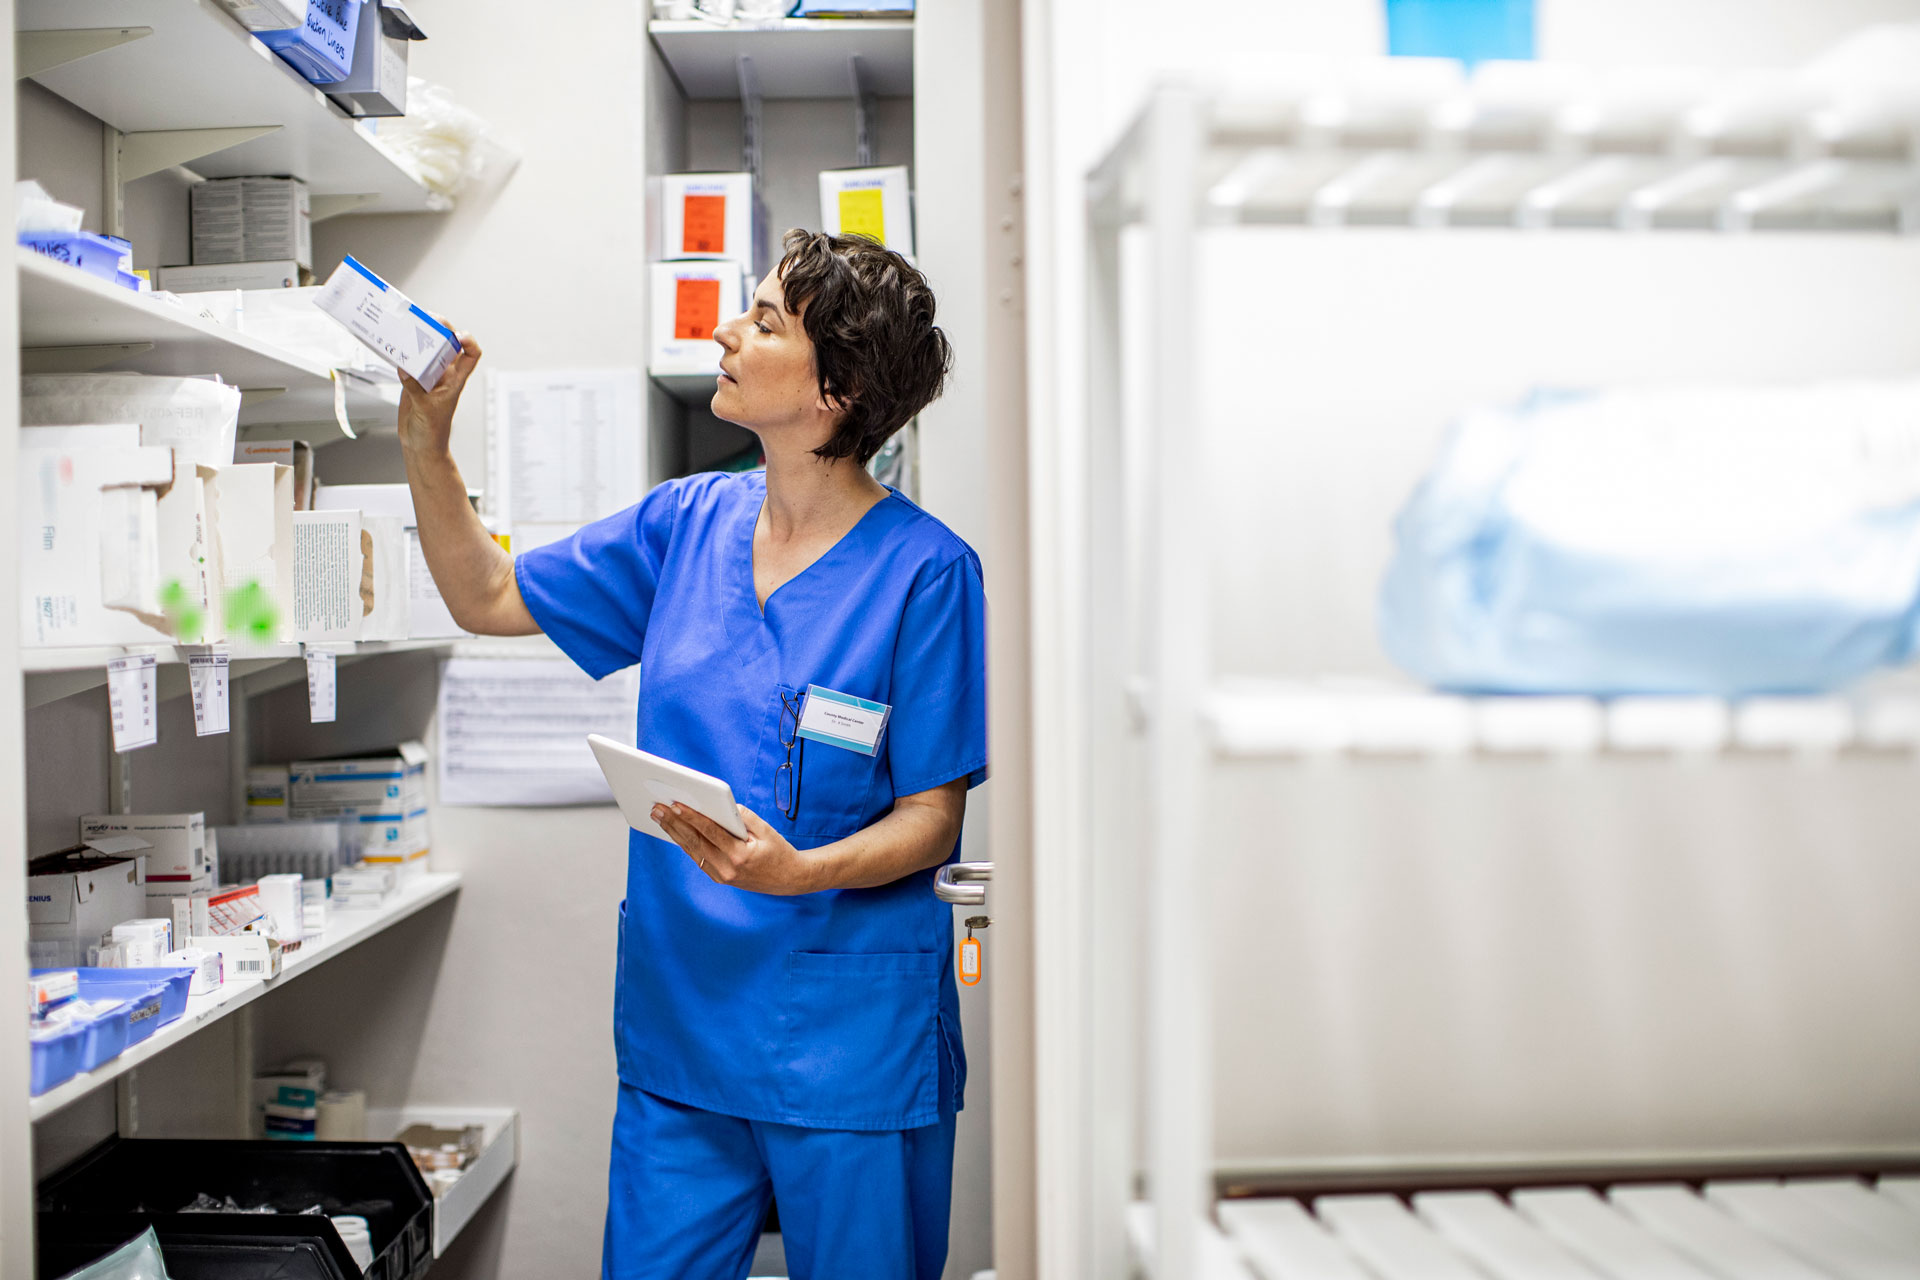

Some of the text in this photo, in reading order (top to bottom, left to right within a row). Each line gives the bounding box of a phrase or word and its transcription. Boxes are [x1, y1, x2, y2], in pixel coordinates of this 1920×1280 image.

[306, 12, 345, 60] Suction Liners
[43, 525, 55, 551] Film
[27, 895, 52, 903] ENIUS
